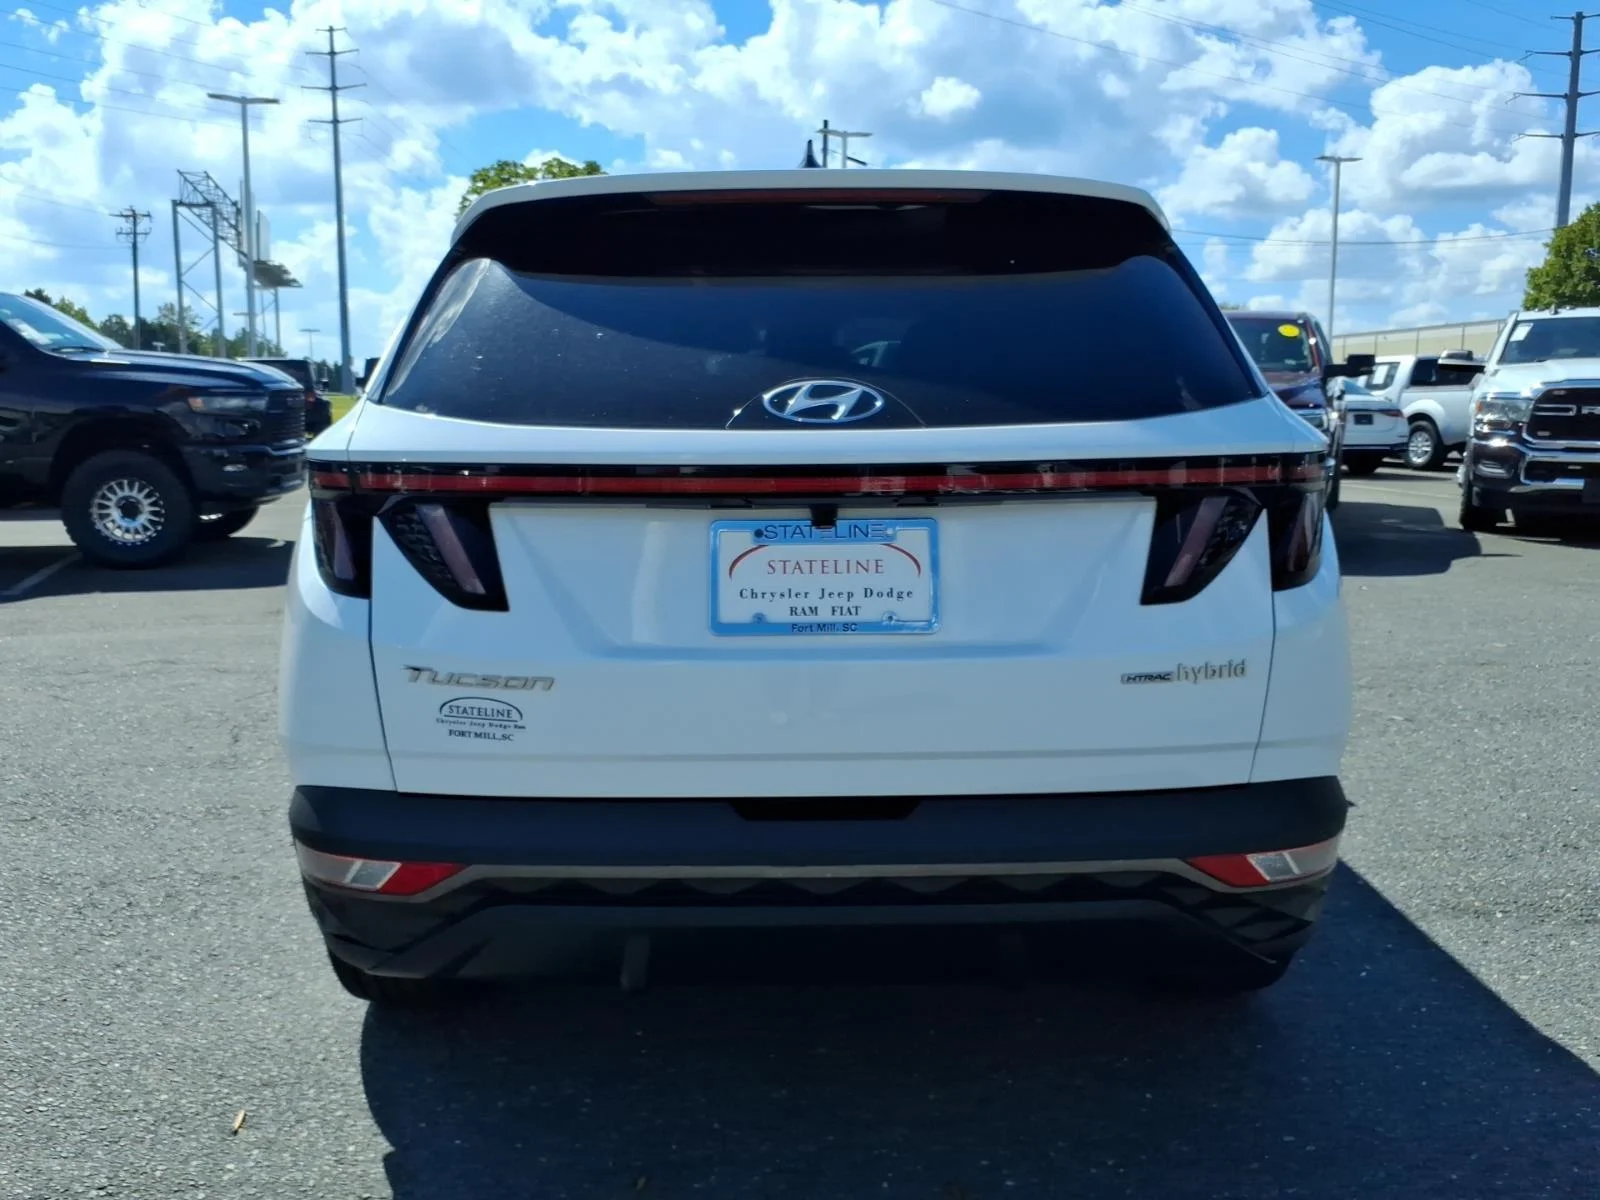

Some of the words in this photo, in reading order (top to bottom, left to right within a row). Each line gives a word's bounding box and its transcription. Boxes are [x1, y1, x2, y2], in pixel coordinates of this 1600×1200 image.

[767, 559, 885, 575] STATELINE
[739, 588, 810, 602] Chrysler
[818, 588, 855, 602] Jeep
[863, 587, 914, 602] Dodge
[789, 606, 819, 616] RAM
[831, 605, 862, 616] FIAT
[791, 623, 814, 633] Fort
[842, 623, 858, 632] SC
[1176, 658, 1247, 685] hybrid
[448, 704, 514, 719] STATELINE
[448, 728, 472, 739] FORT
